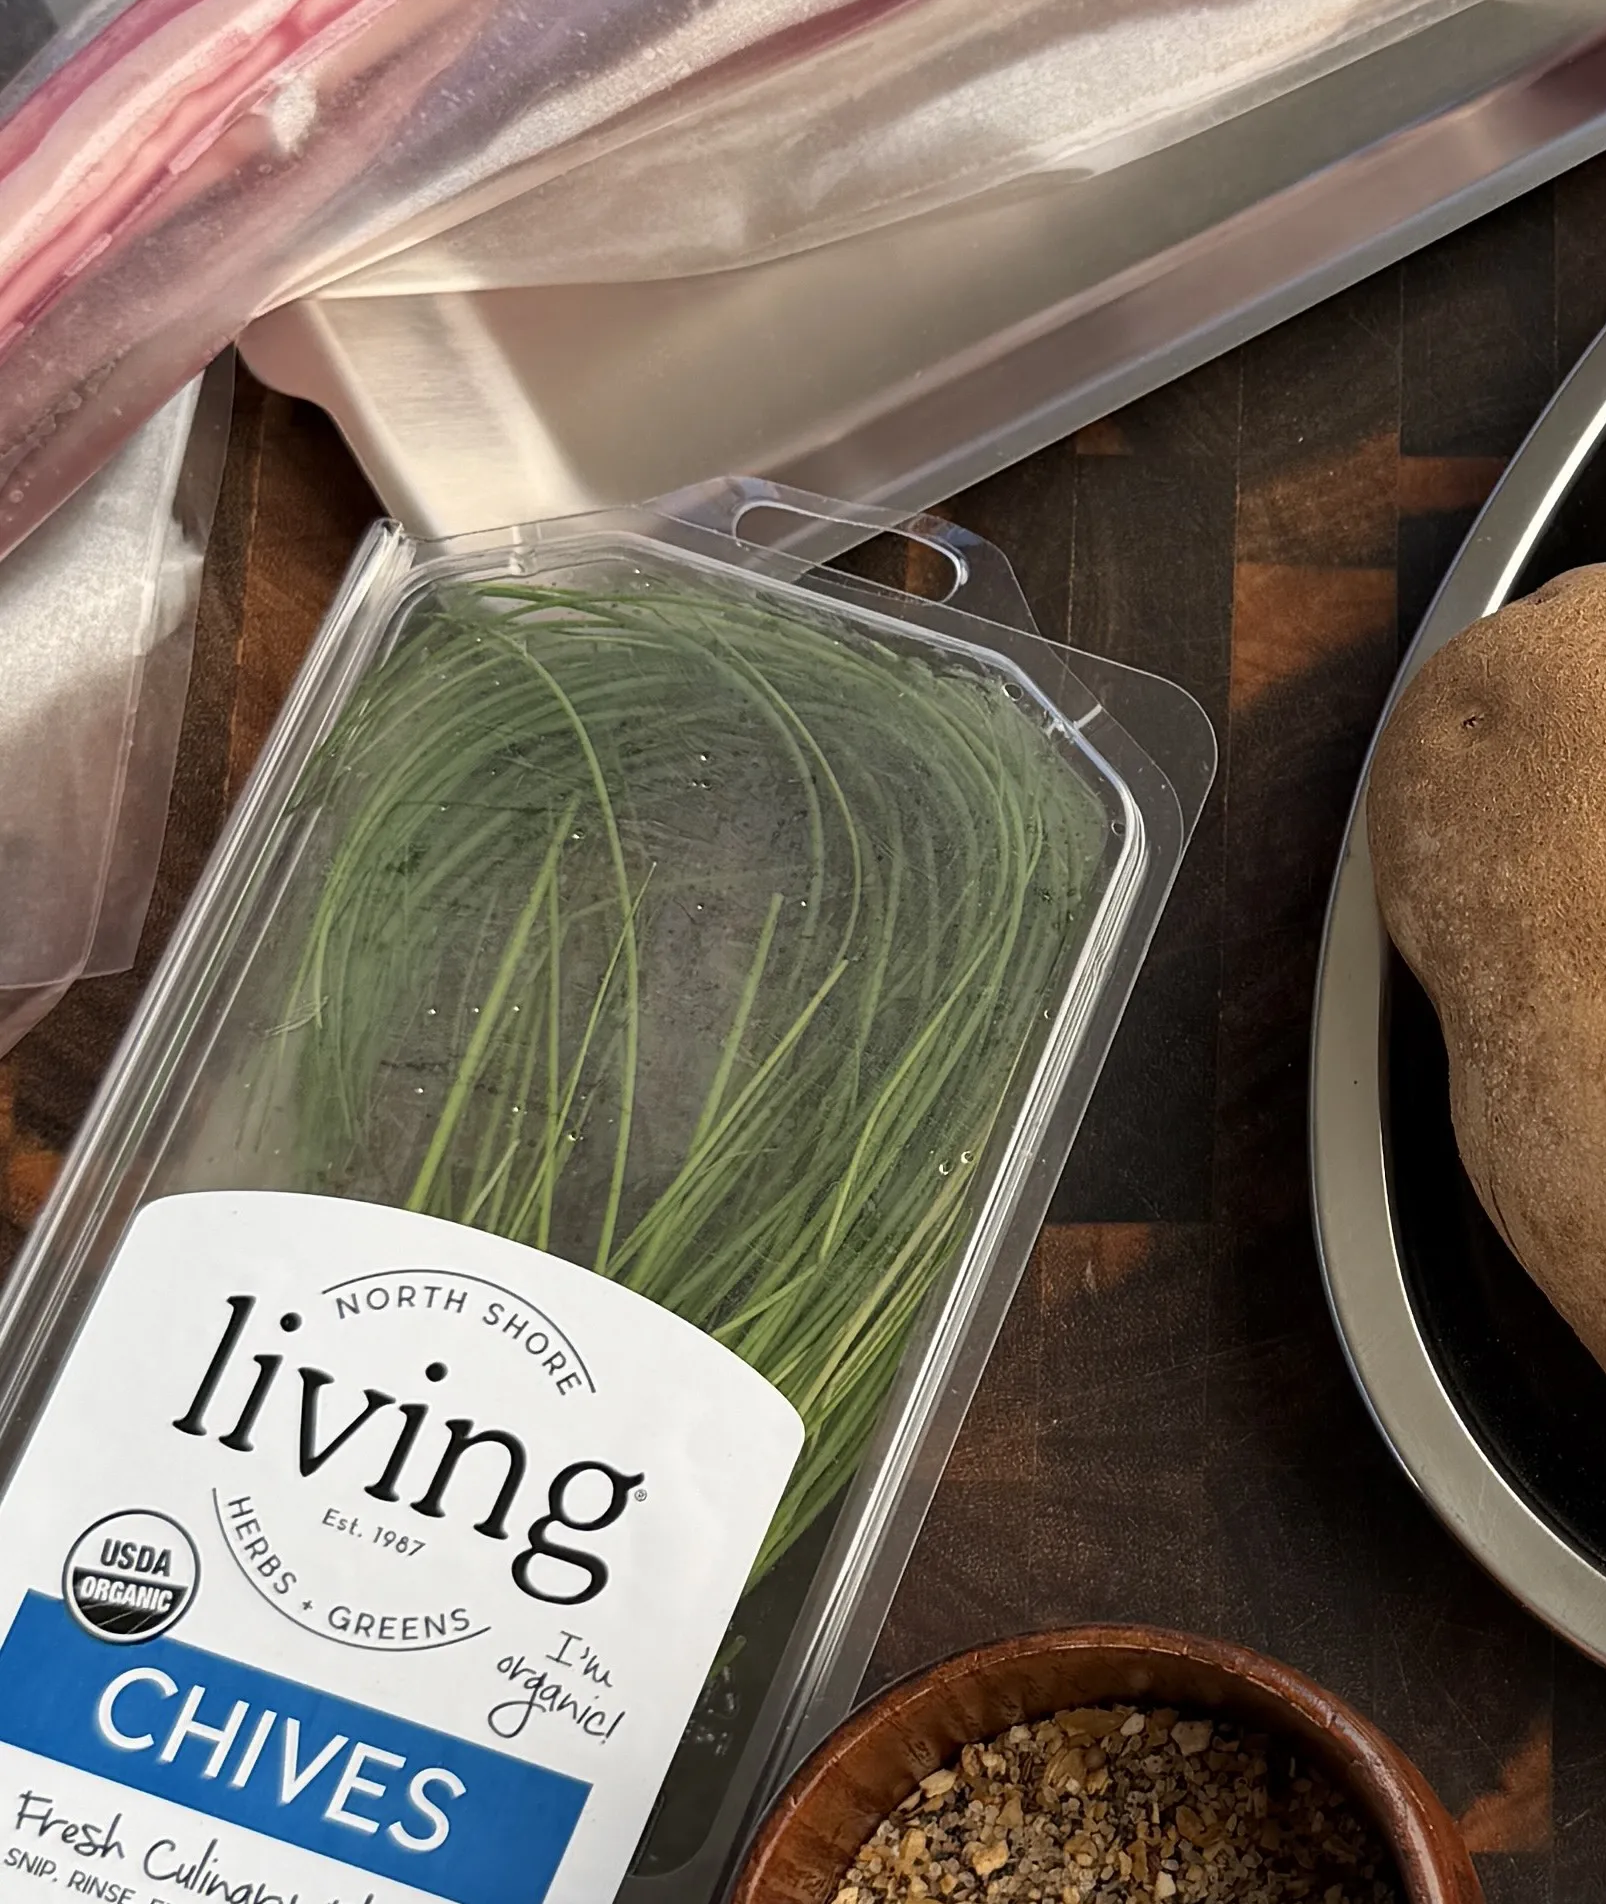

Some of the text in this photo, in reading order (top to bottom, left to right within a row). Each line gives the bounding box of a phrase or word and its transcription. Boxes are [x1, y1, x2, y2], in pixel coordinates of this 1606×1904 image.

[334, 1283, 583, 1397] NORTH SHORE
[101, 1538, 172, 1577] USDA
[226, 1493, 298, 1595] HERBS
[327, 1606, 473, 1641] GREENS
[321, 1507, 427, 1559] Est. 1987
[79, 1575, 173, 1613] ORGANIC
[487, 1653, 627, 1743] organic!
[98, 1666, 467, 1852] CHIVES
[15, 1787, 126, 1859] Fresh
[4, 1847, 58, 1883] SNIP.
